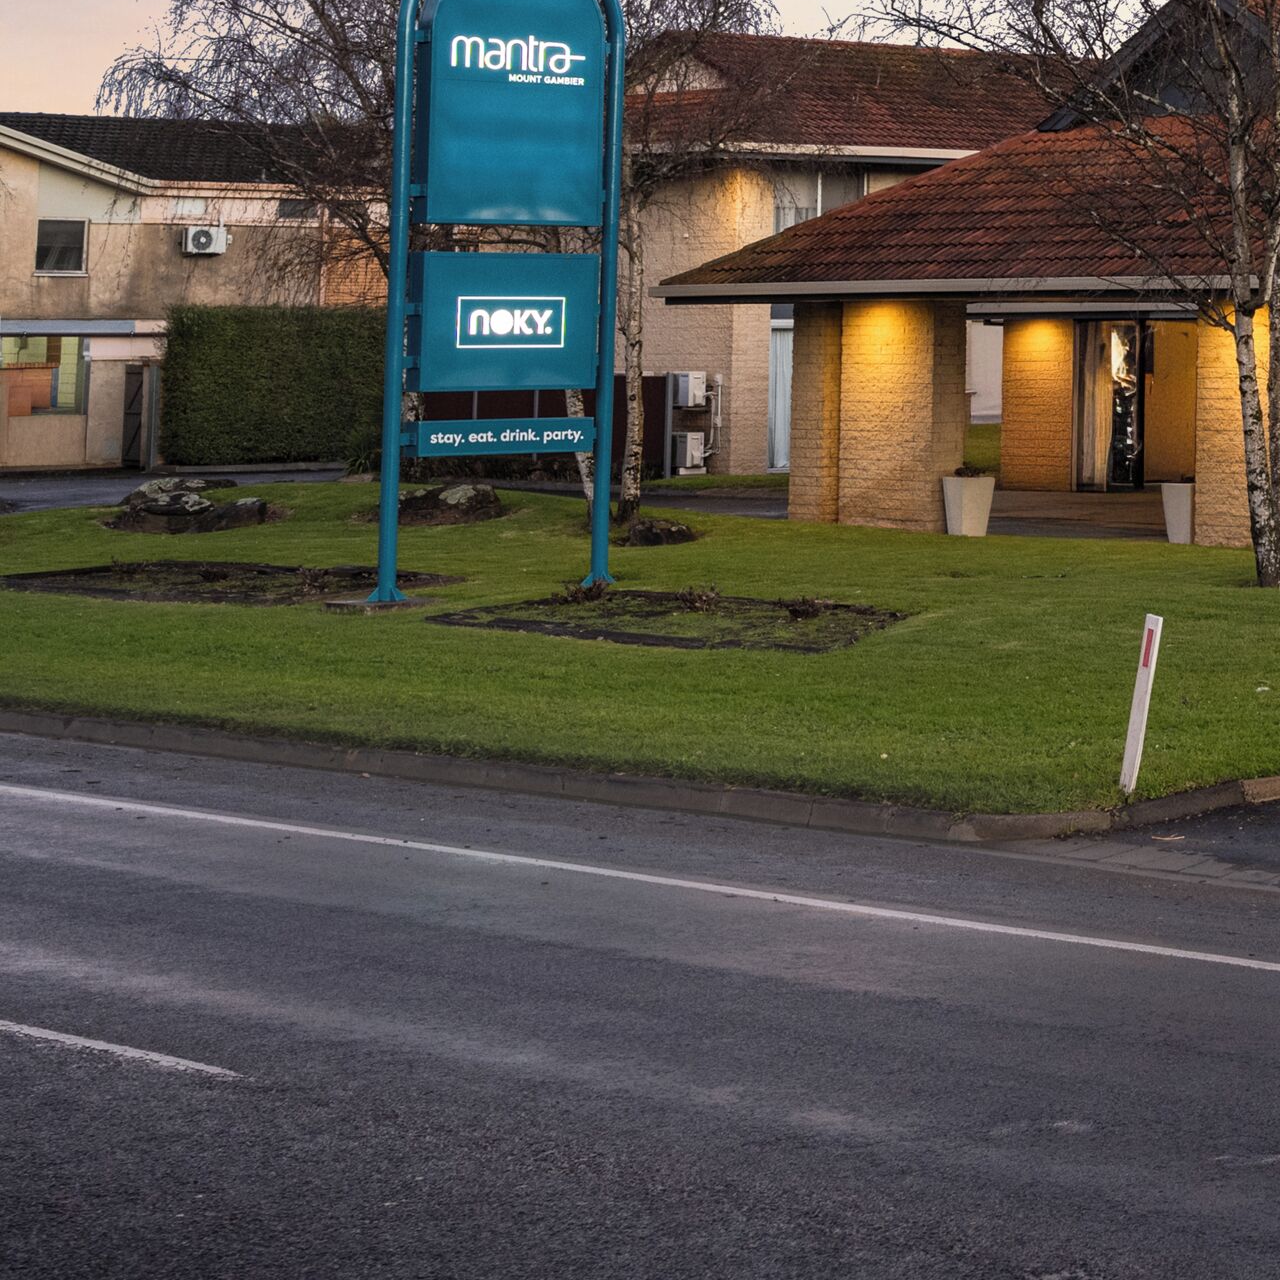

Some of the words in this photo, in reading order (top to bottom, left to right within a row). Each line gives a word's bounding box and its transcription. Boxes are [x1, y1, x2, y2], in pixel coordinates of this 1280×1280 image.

[450, 35, 586, 74] mantra
[508, 74, 542, 84] MOUNT
[543, 76, 585, 86] GAMBIER
[430, 432, 465, 446] stay.
[468, 431, 497, 443] eat.
[500, 428, 540, 442] drink.
[543, 429, 584, 444] party.
